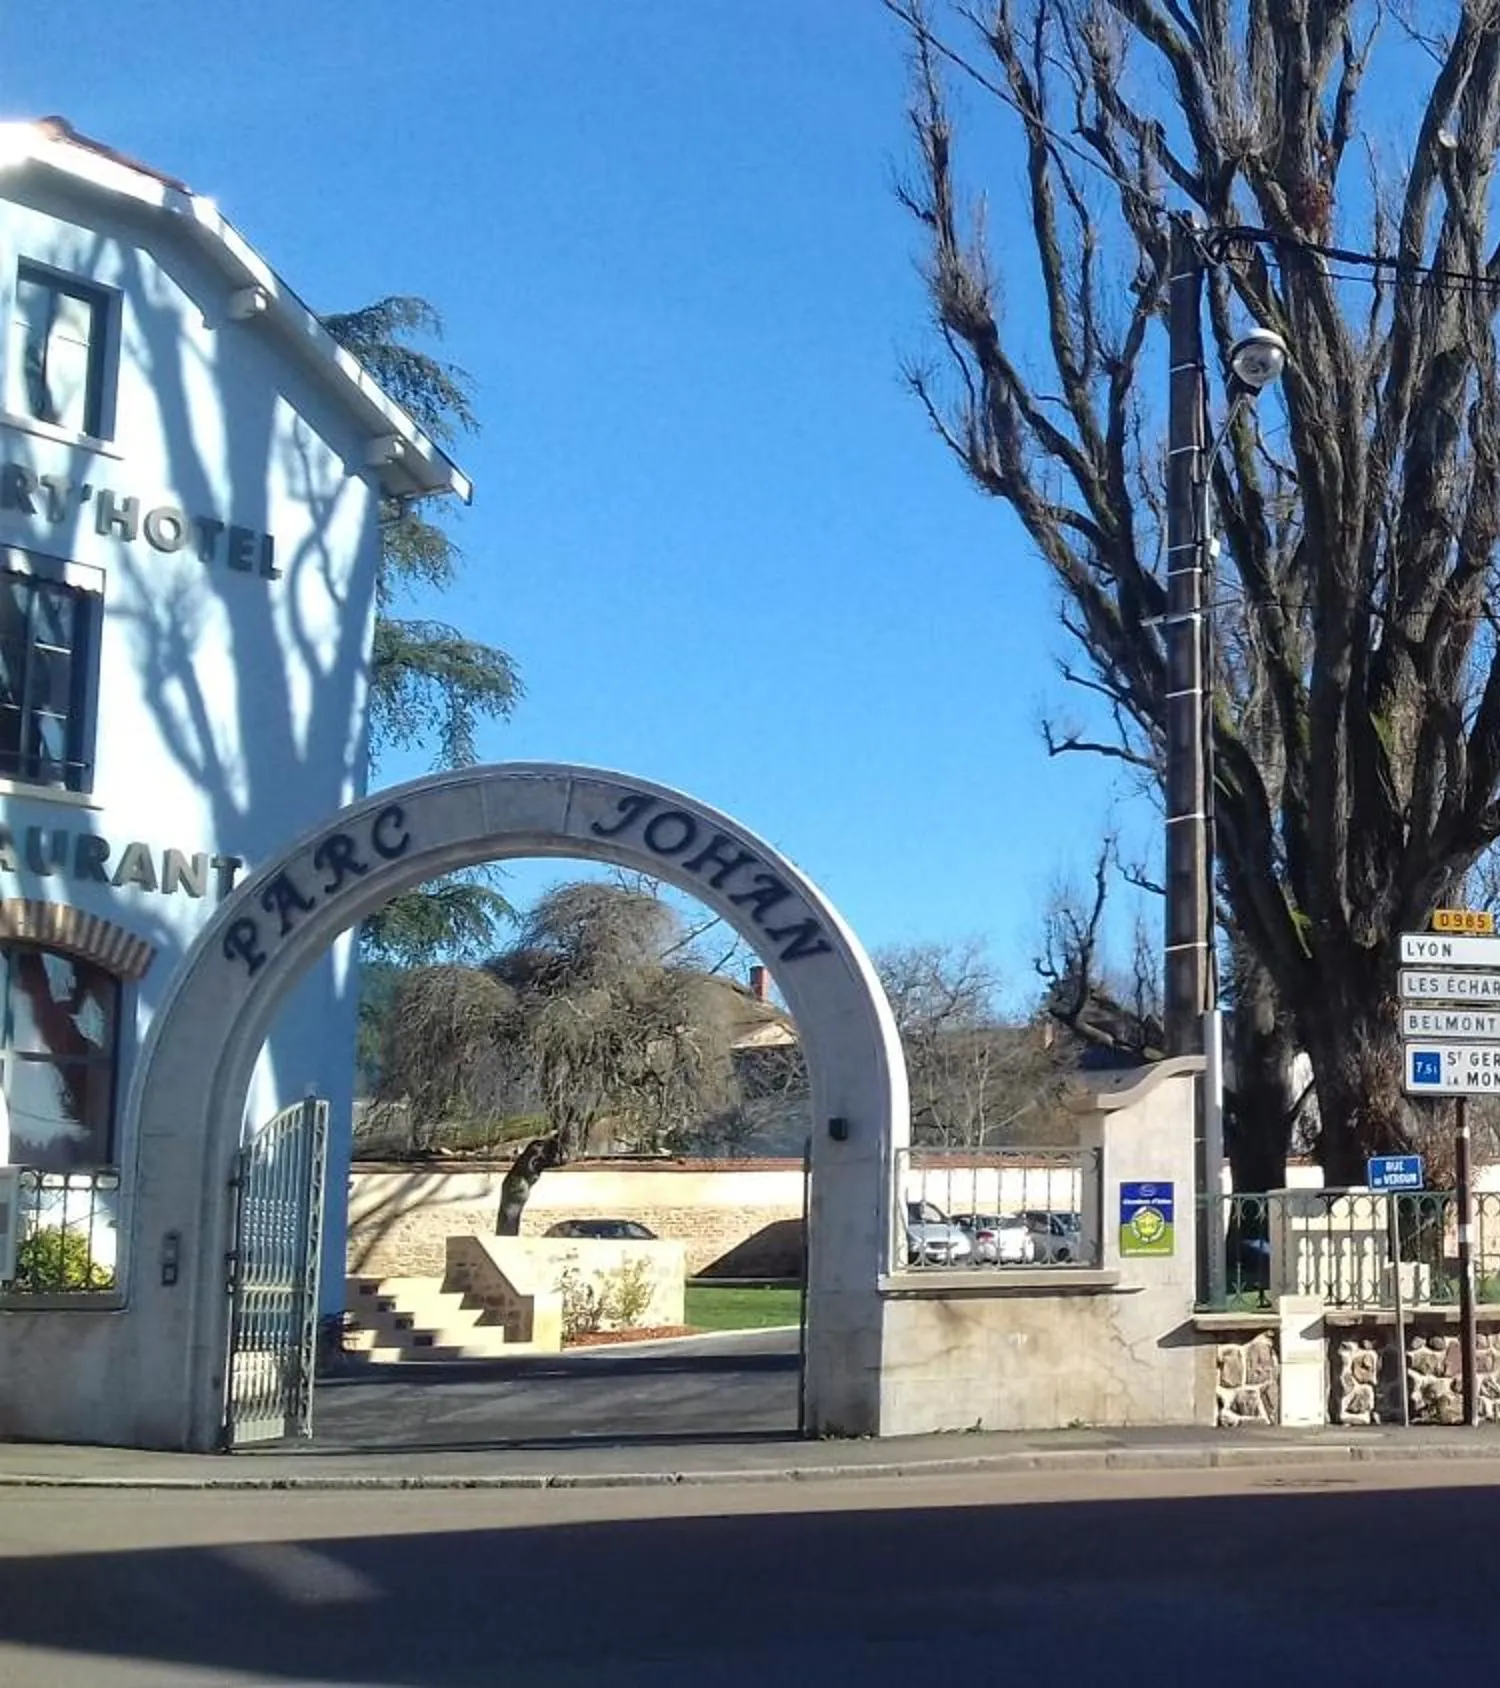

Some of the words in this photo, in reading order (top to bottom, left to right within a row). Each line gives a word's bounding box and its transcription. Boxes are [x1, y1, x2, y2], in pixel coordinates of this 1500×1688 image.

[223, 804, 411, 978] PARC
[590, 794, 833, 962] JOHAN
[1406, 942, 1452, 958] LYON
[1407, 977, 1439, 993] LES
[1409, 1015, 1496, 1034] BELMONT
[1385, 1161, 1405, 1172] RUE
